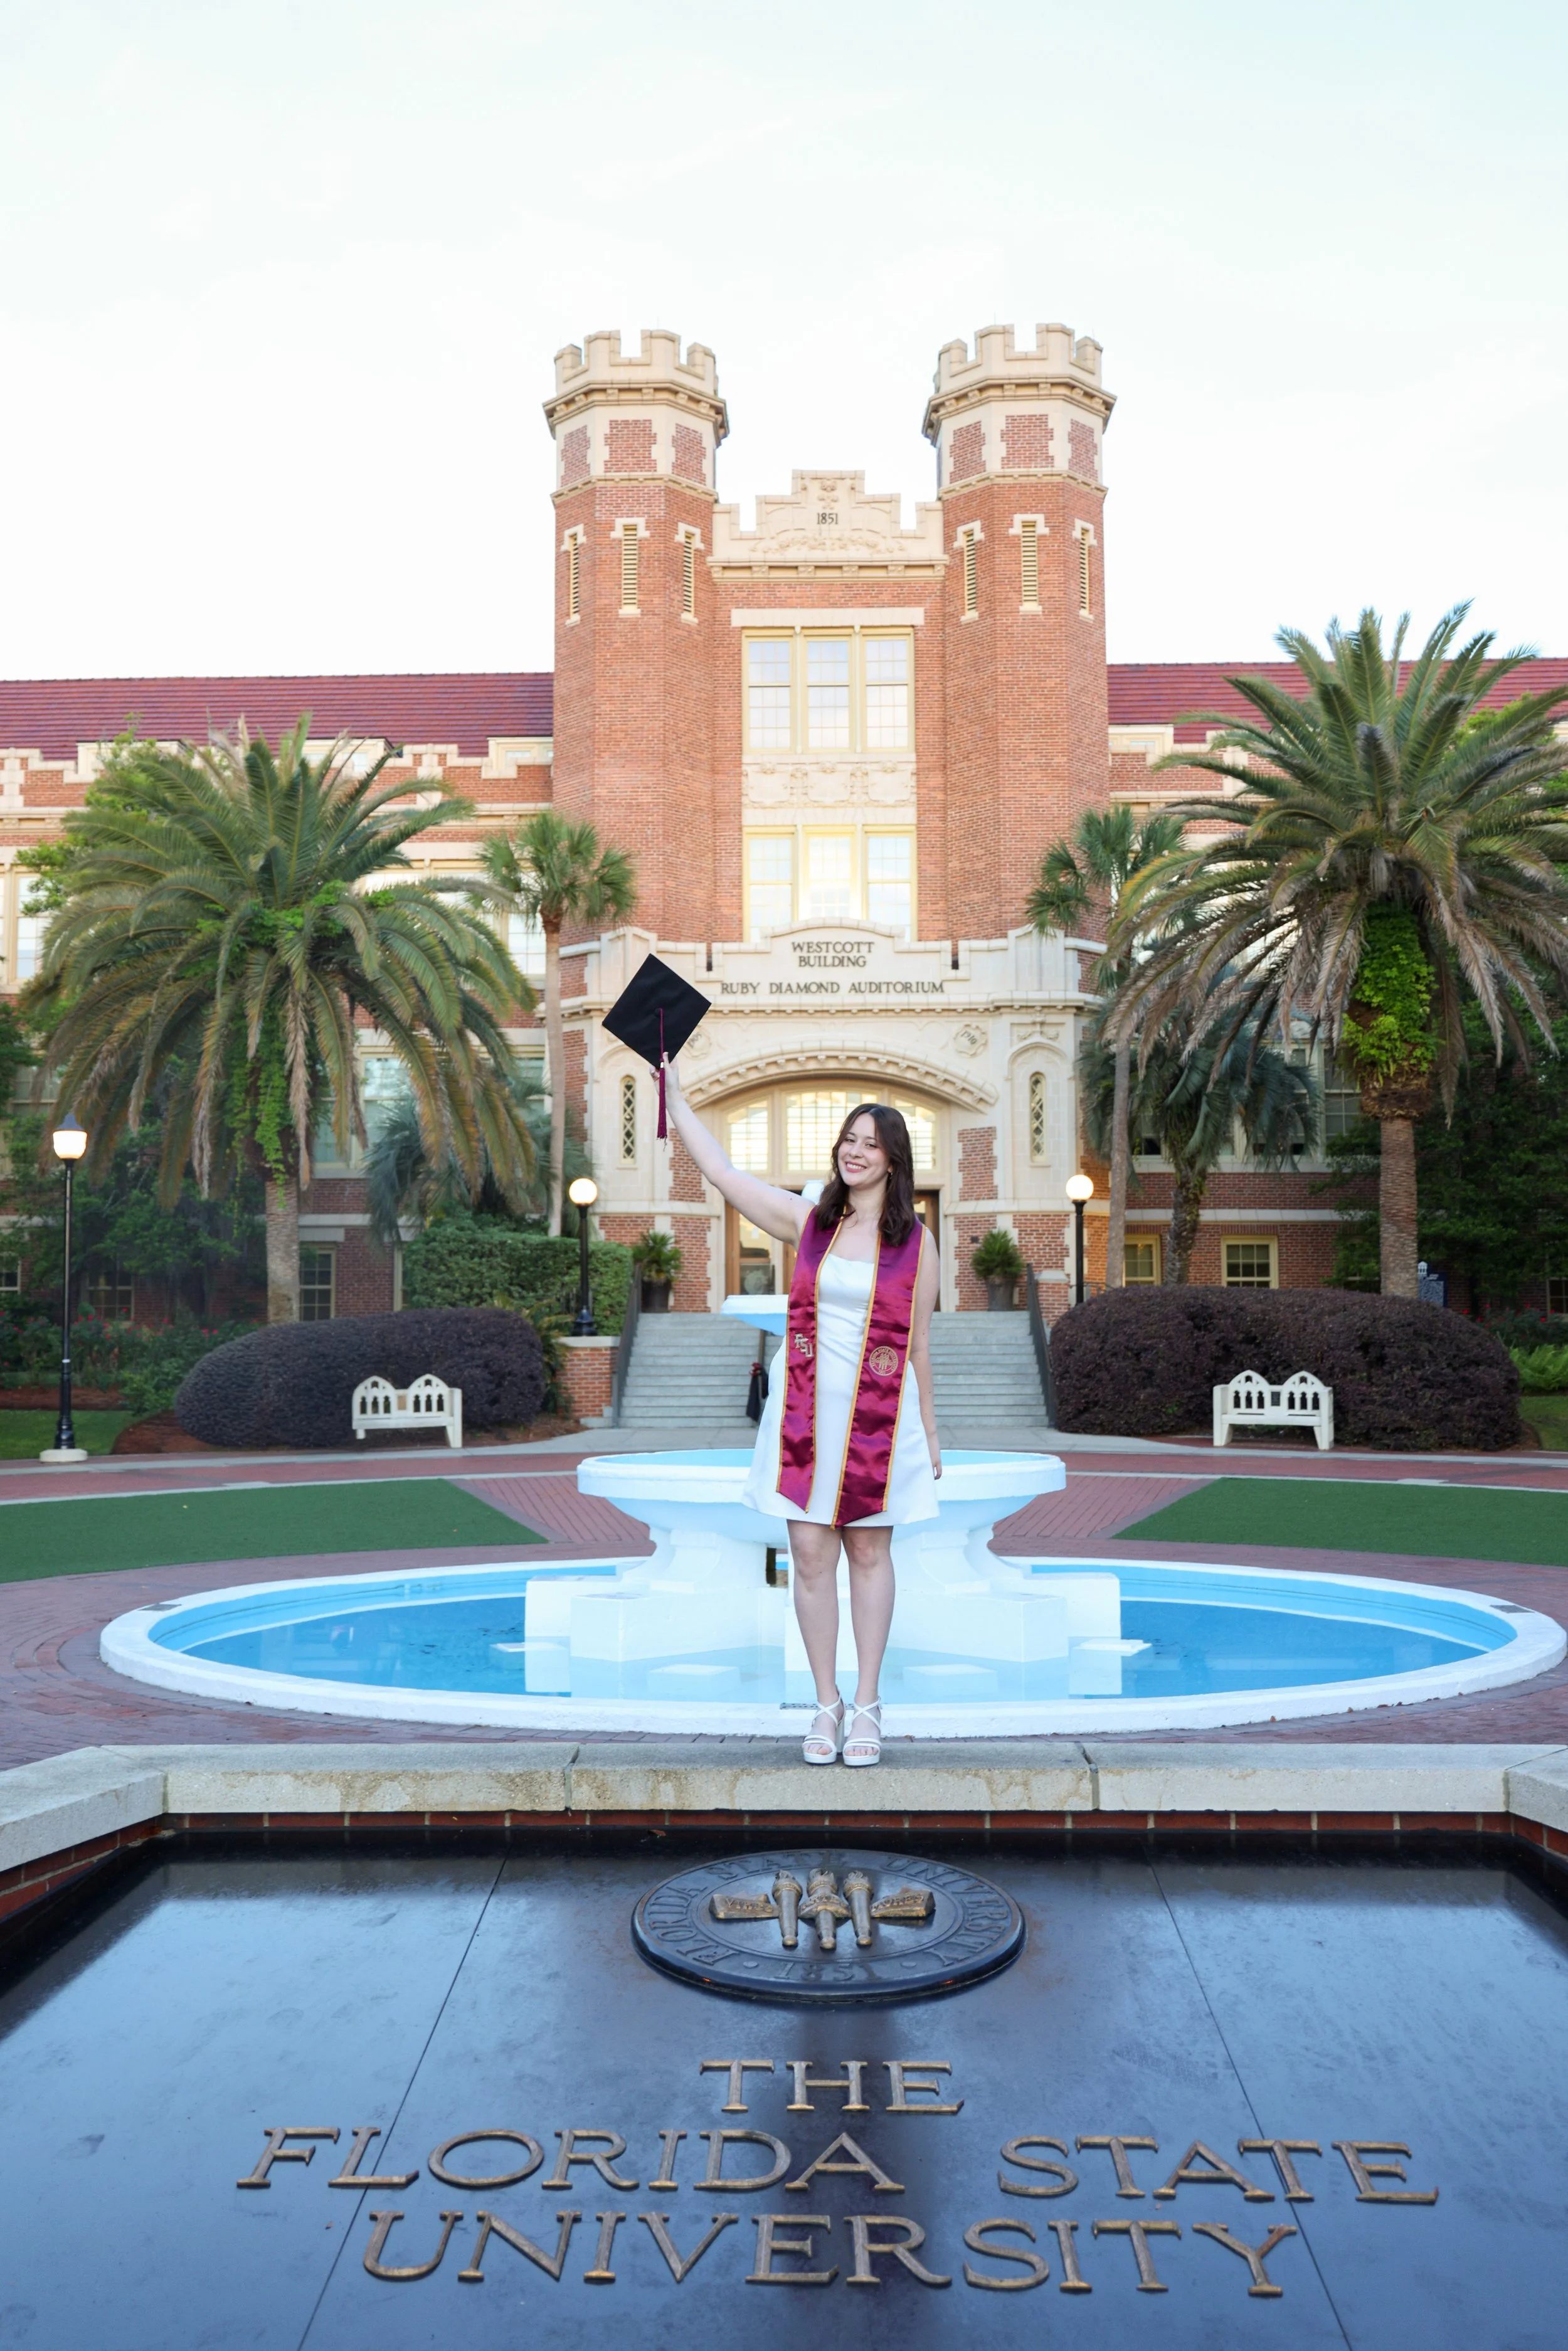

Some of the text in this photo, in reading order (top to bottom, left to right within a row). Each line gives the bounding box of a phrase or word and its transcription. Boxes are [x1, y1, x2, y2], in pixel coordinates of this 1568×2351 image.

[817, 512, 839, 524] 1851
[792, 942, 874, 953] WESTCOTT
[798, 956, 866, 967] BUILDING
[721, 980, 945, 994] RUBY DIAMOND AUDITORIUM
[794, 1333, 813, 1358] FSU
[647, 1852, 1009, 1966] FLORIDA STATE UNIVERSITY
[773, 1961, 882, 1981] 1851
[699, 2059, 965, 2114] THE
[236, 2126, 1440, 2205] FLORIDA STATE
[361, 2210, 1299, 2298] UNIVERSITY
